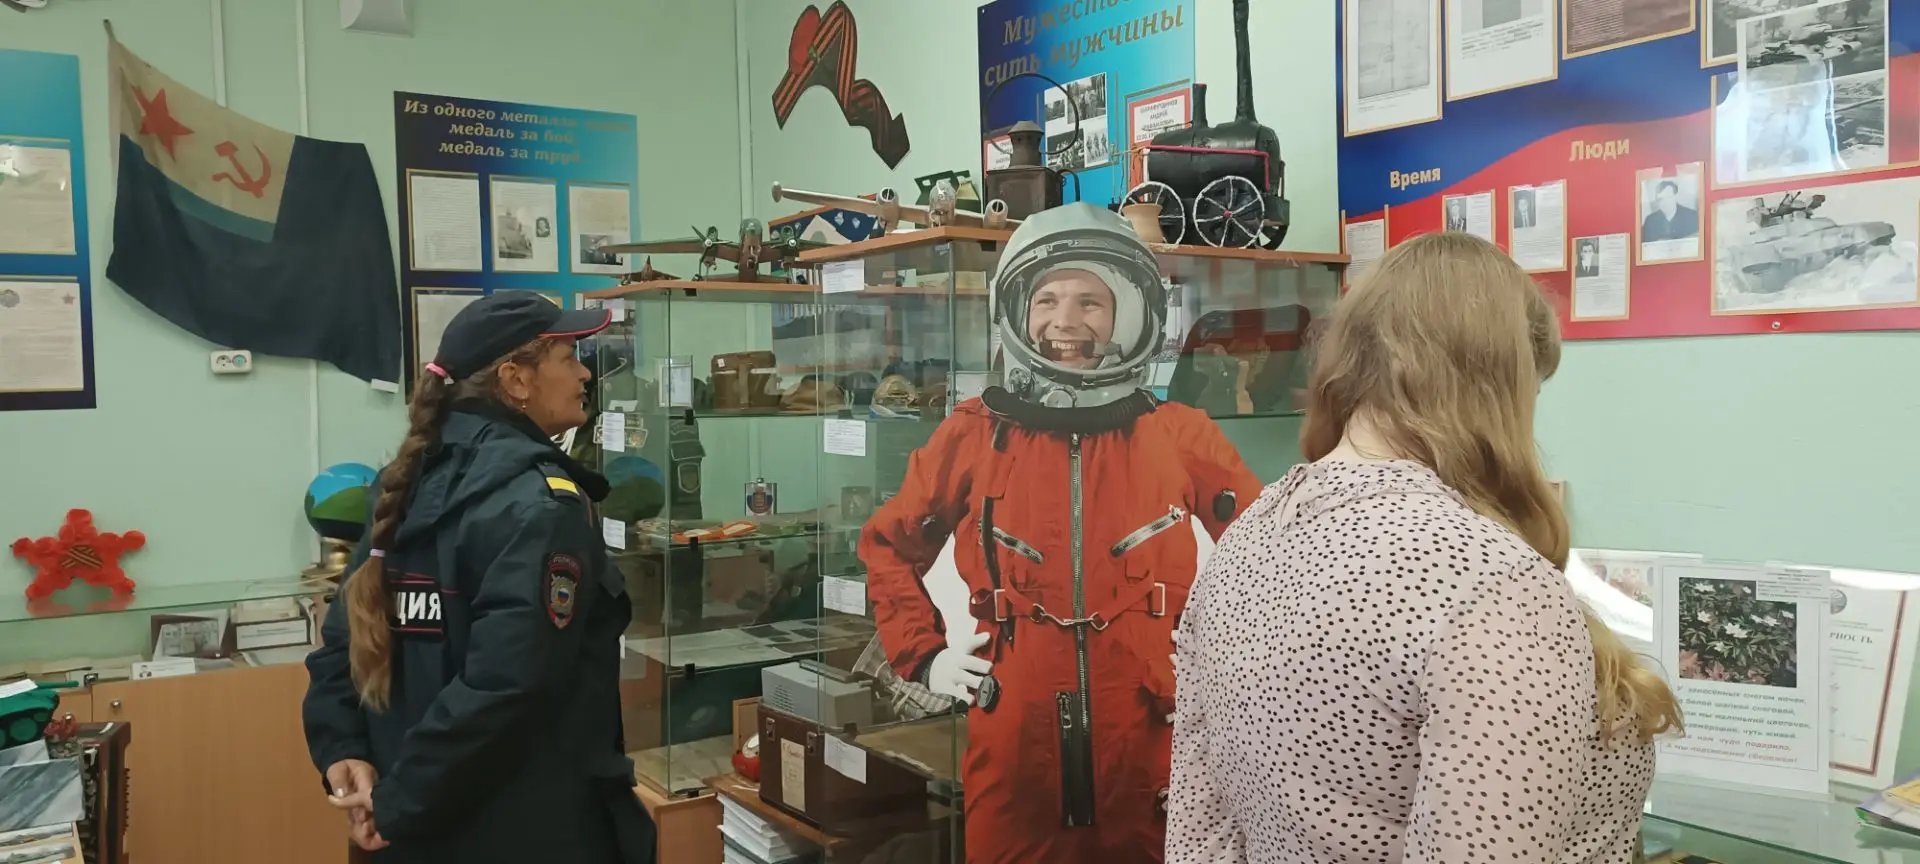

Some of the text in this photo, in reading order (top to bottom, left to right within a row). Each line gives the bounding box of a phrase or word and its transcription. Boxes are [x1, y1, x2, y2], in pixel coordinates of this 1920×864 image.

[984, 5, 1184, 87] сить мужчины
[404, 99, 428, 114] Из
[434, 102, 496, 121] одного
[449, 122, 514, 139] медаль
[520, 130, 538, 141] за
[439, 140, 505, 157] медаль
[510, 147, 528, 159] за
[1569, 138, 1630, 162] Люди
[1390, 167, 1441, 191] Время
[396, 591, 442, 625] ЦИЯ
[1829, 631, 1873, 645] РНОСТЬ
